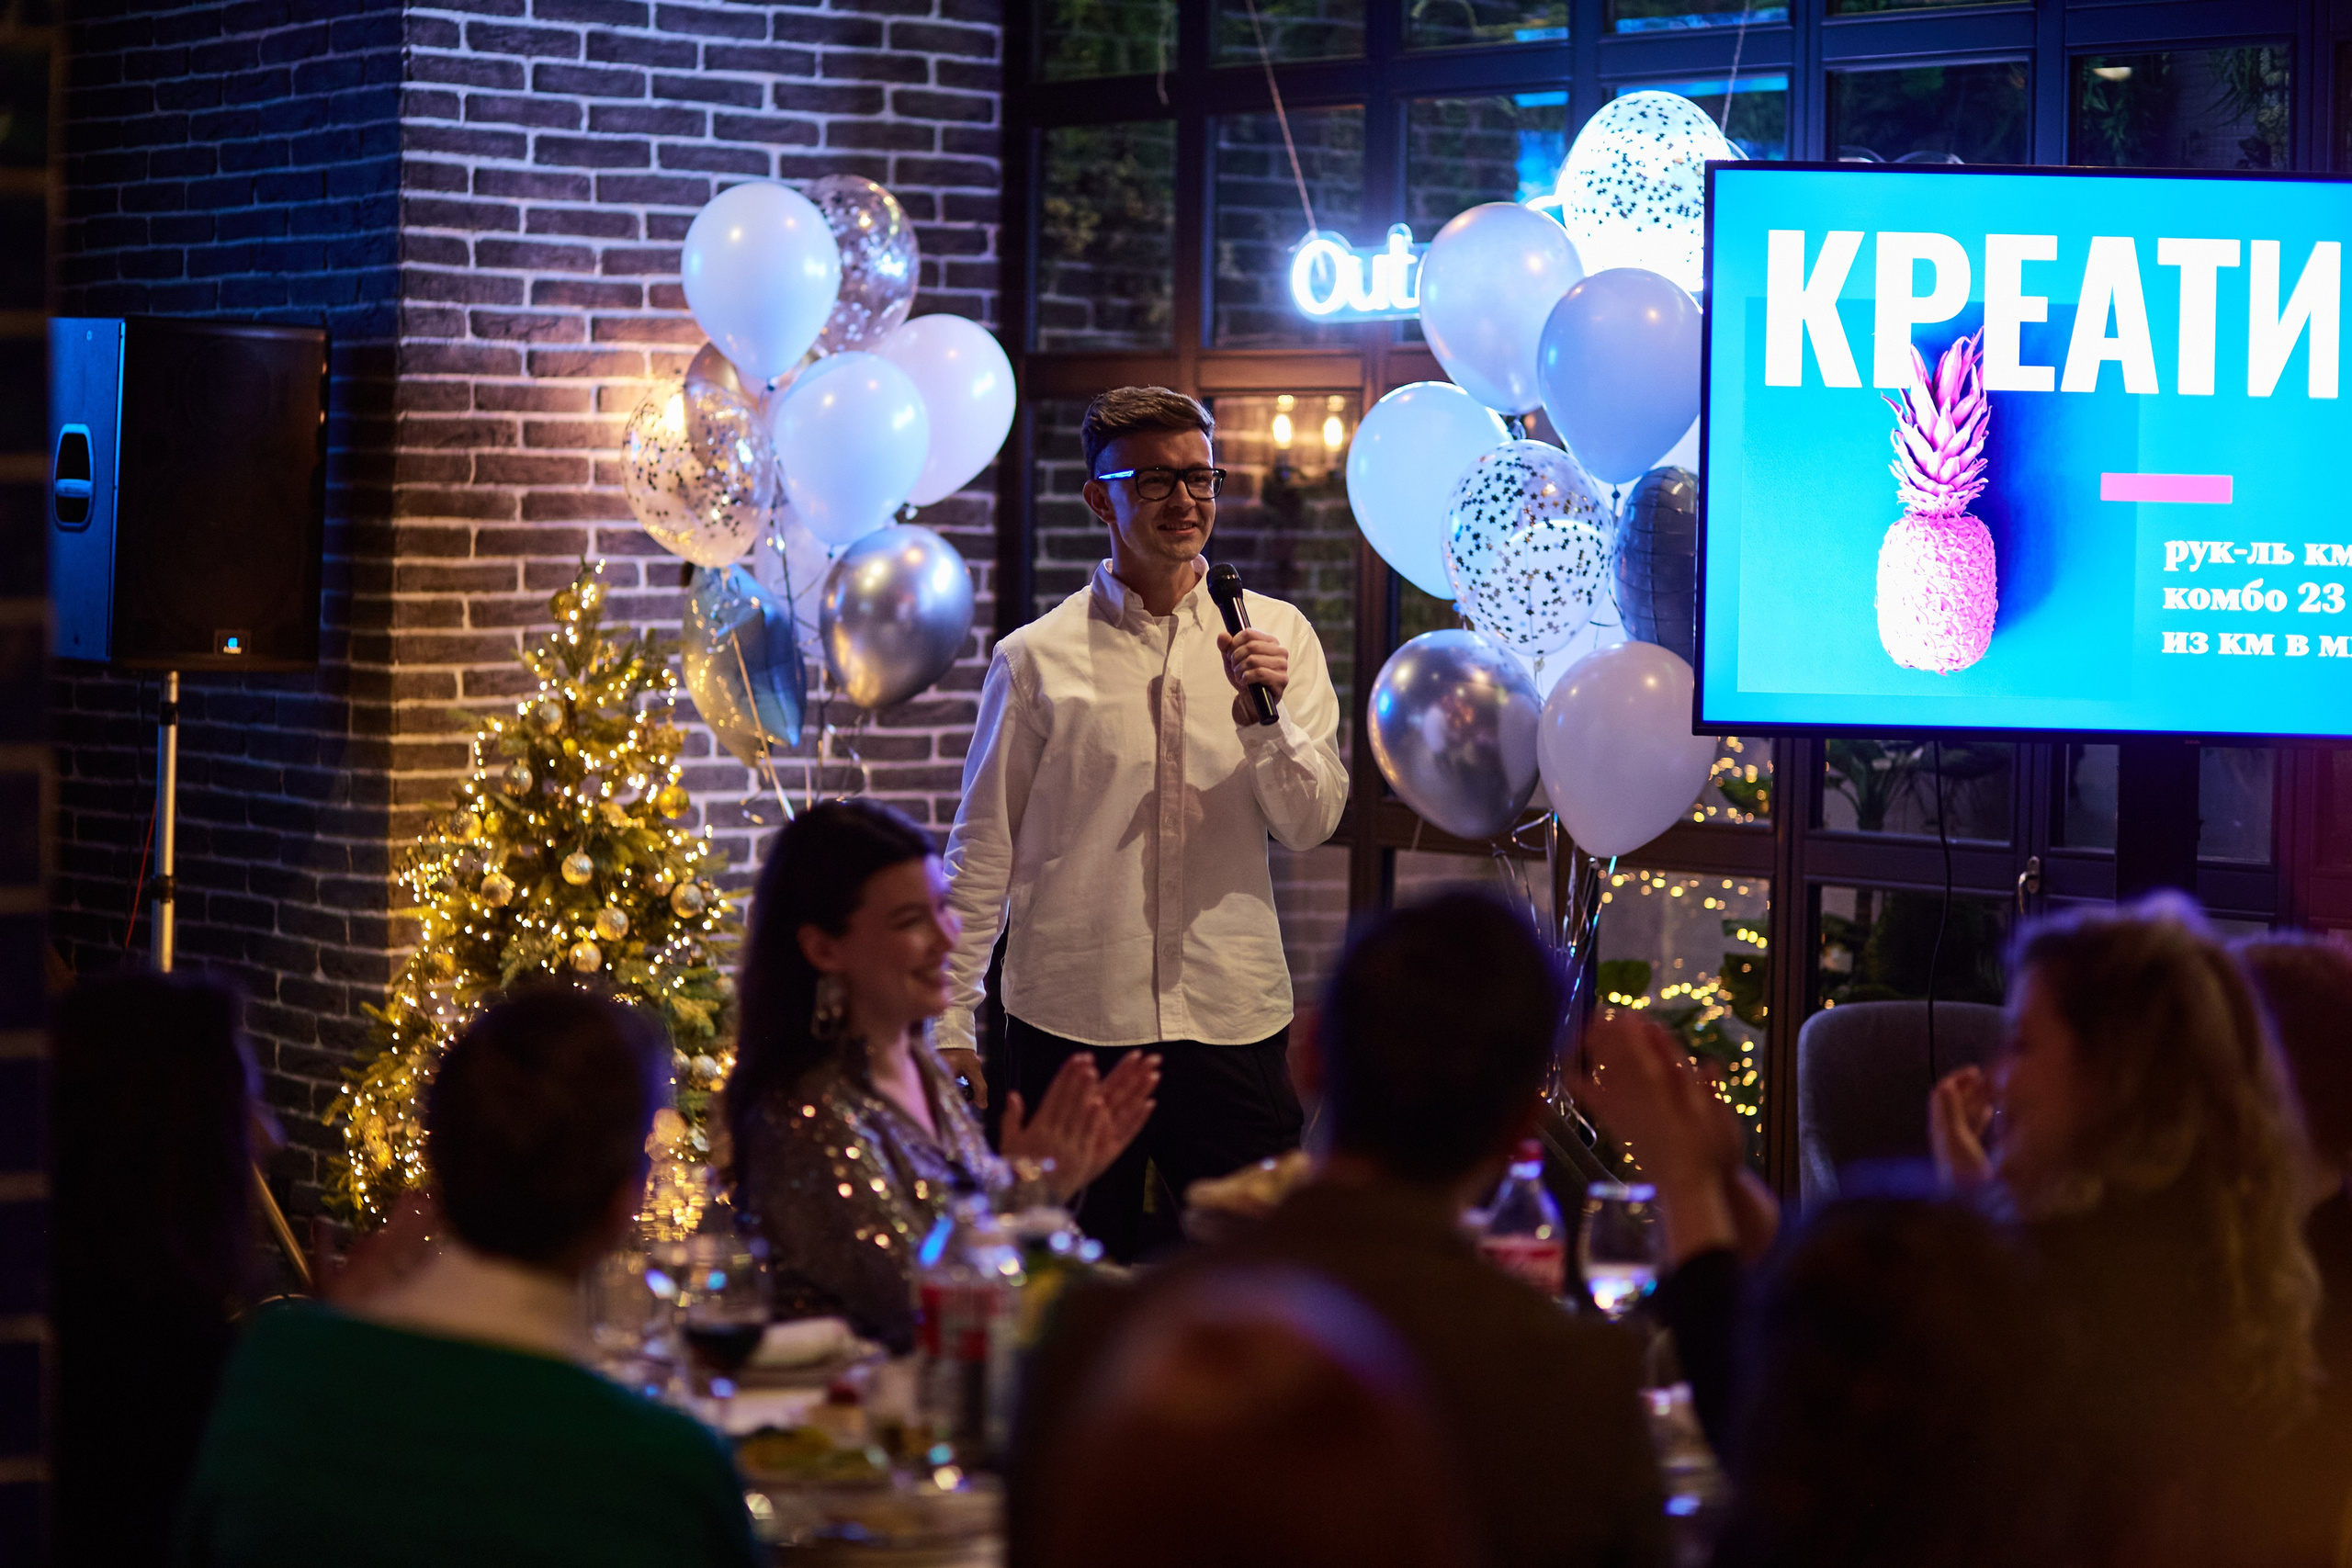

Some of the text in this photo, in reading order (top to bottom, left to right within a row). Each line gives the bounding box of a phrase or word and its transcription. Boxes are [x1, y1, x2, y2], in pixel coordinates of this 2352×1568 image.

[1765, 230, 2341, 399] КРЕАТИ
[2163, 539, 2295, 573] рук-ль
[2162, 577, 2346, 615] комбо 23
[2161, 631, 2352, 658] из км в м
